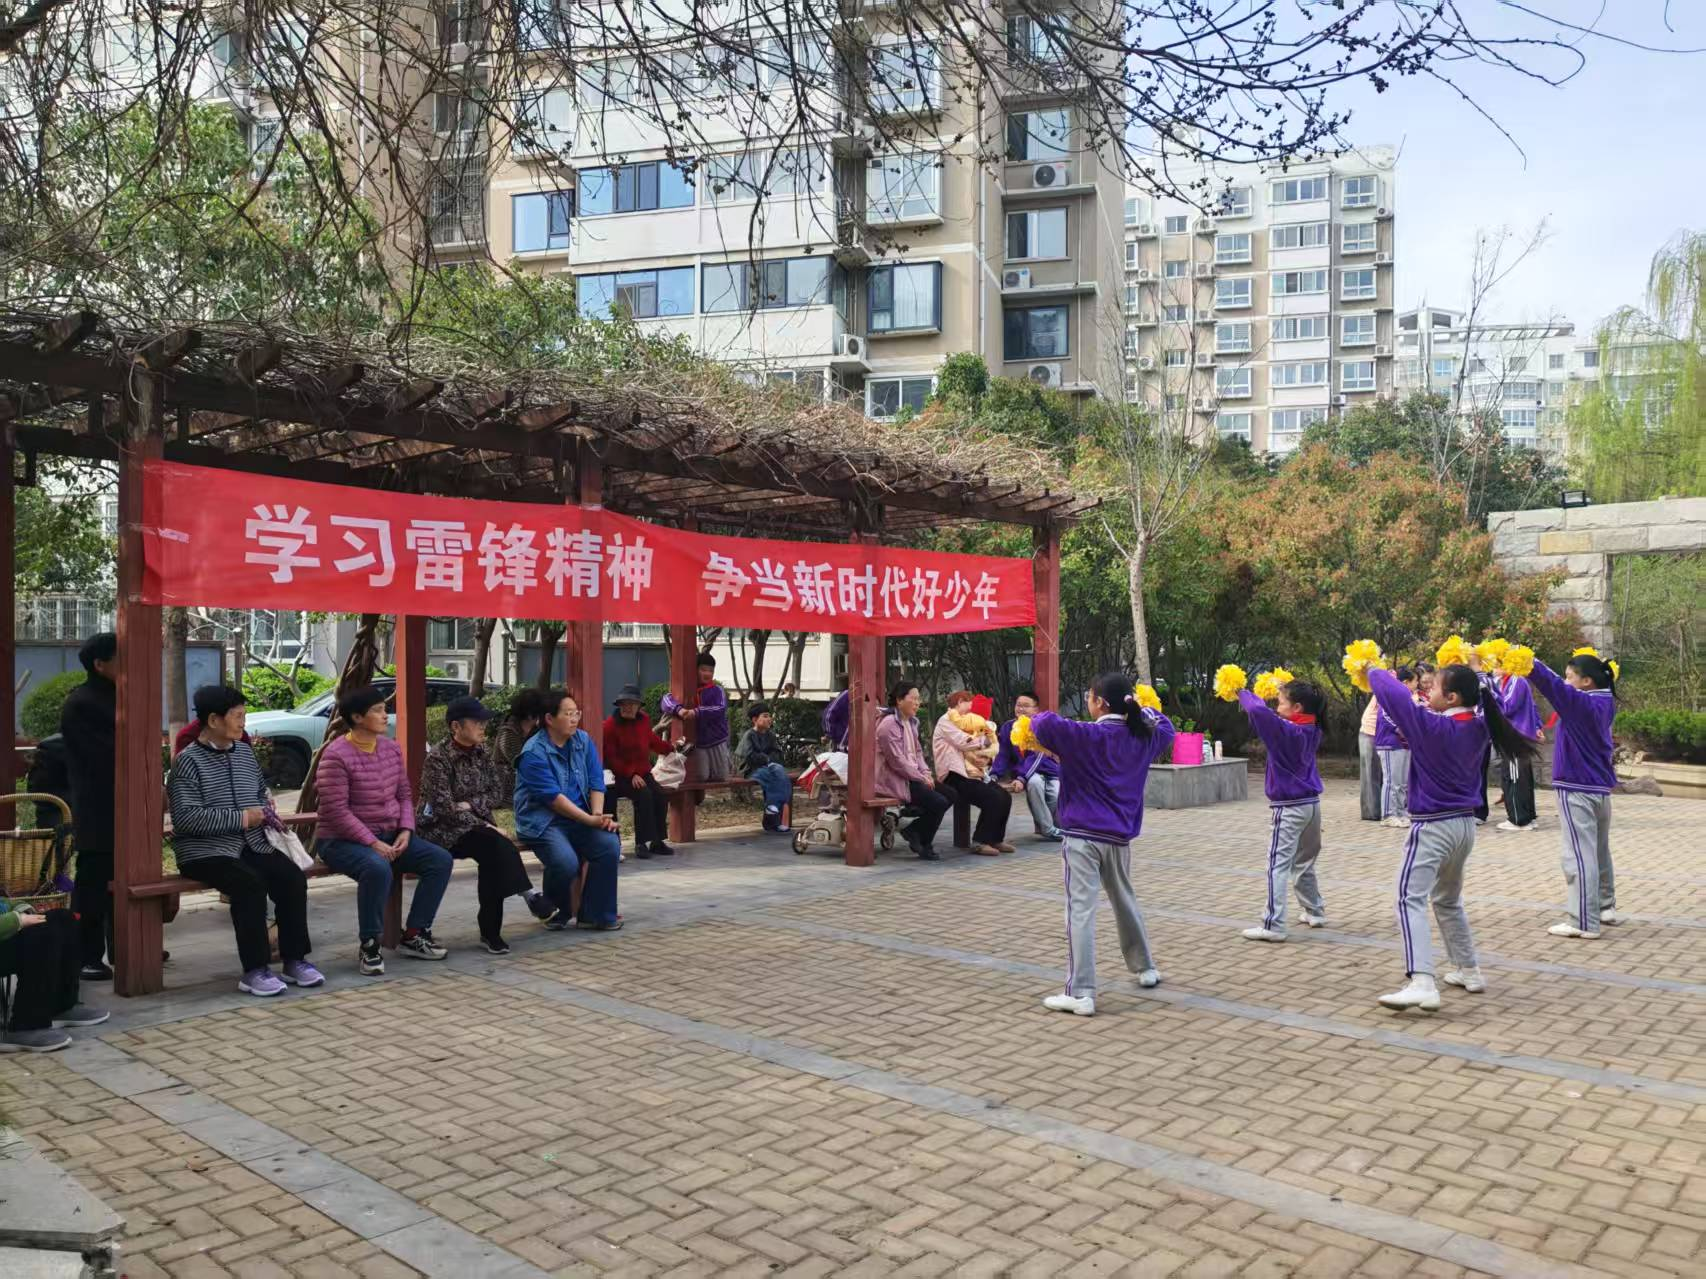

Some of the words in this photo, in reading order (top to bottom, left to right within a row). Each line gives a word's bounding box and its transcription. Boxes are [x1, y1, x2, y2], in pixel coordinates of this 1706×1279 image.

[244, 504, 654, 602] 学习雷锋精神
[701, 551, 1001, 620] 争当新时代好少年
